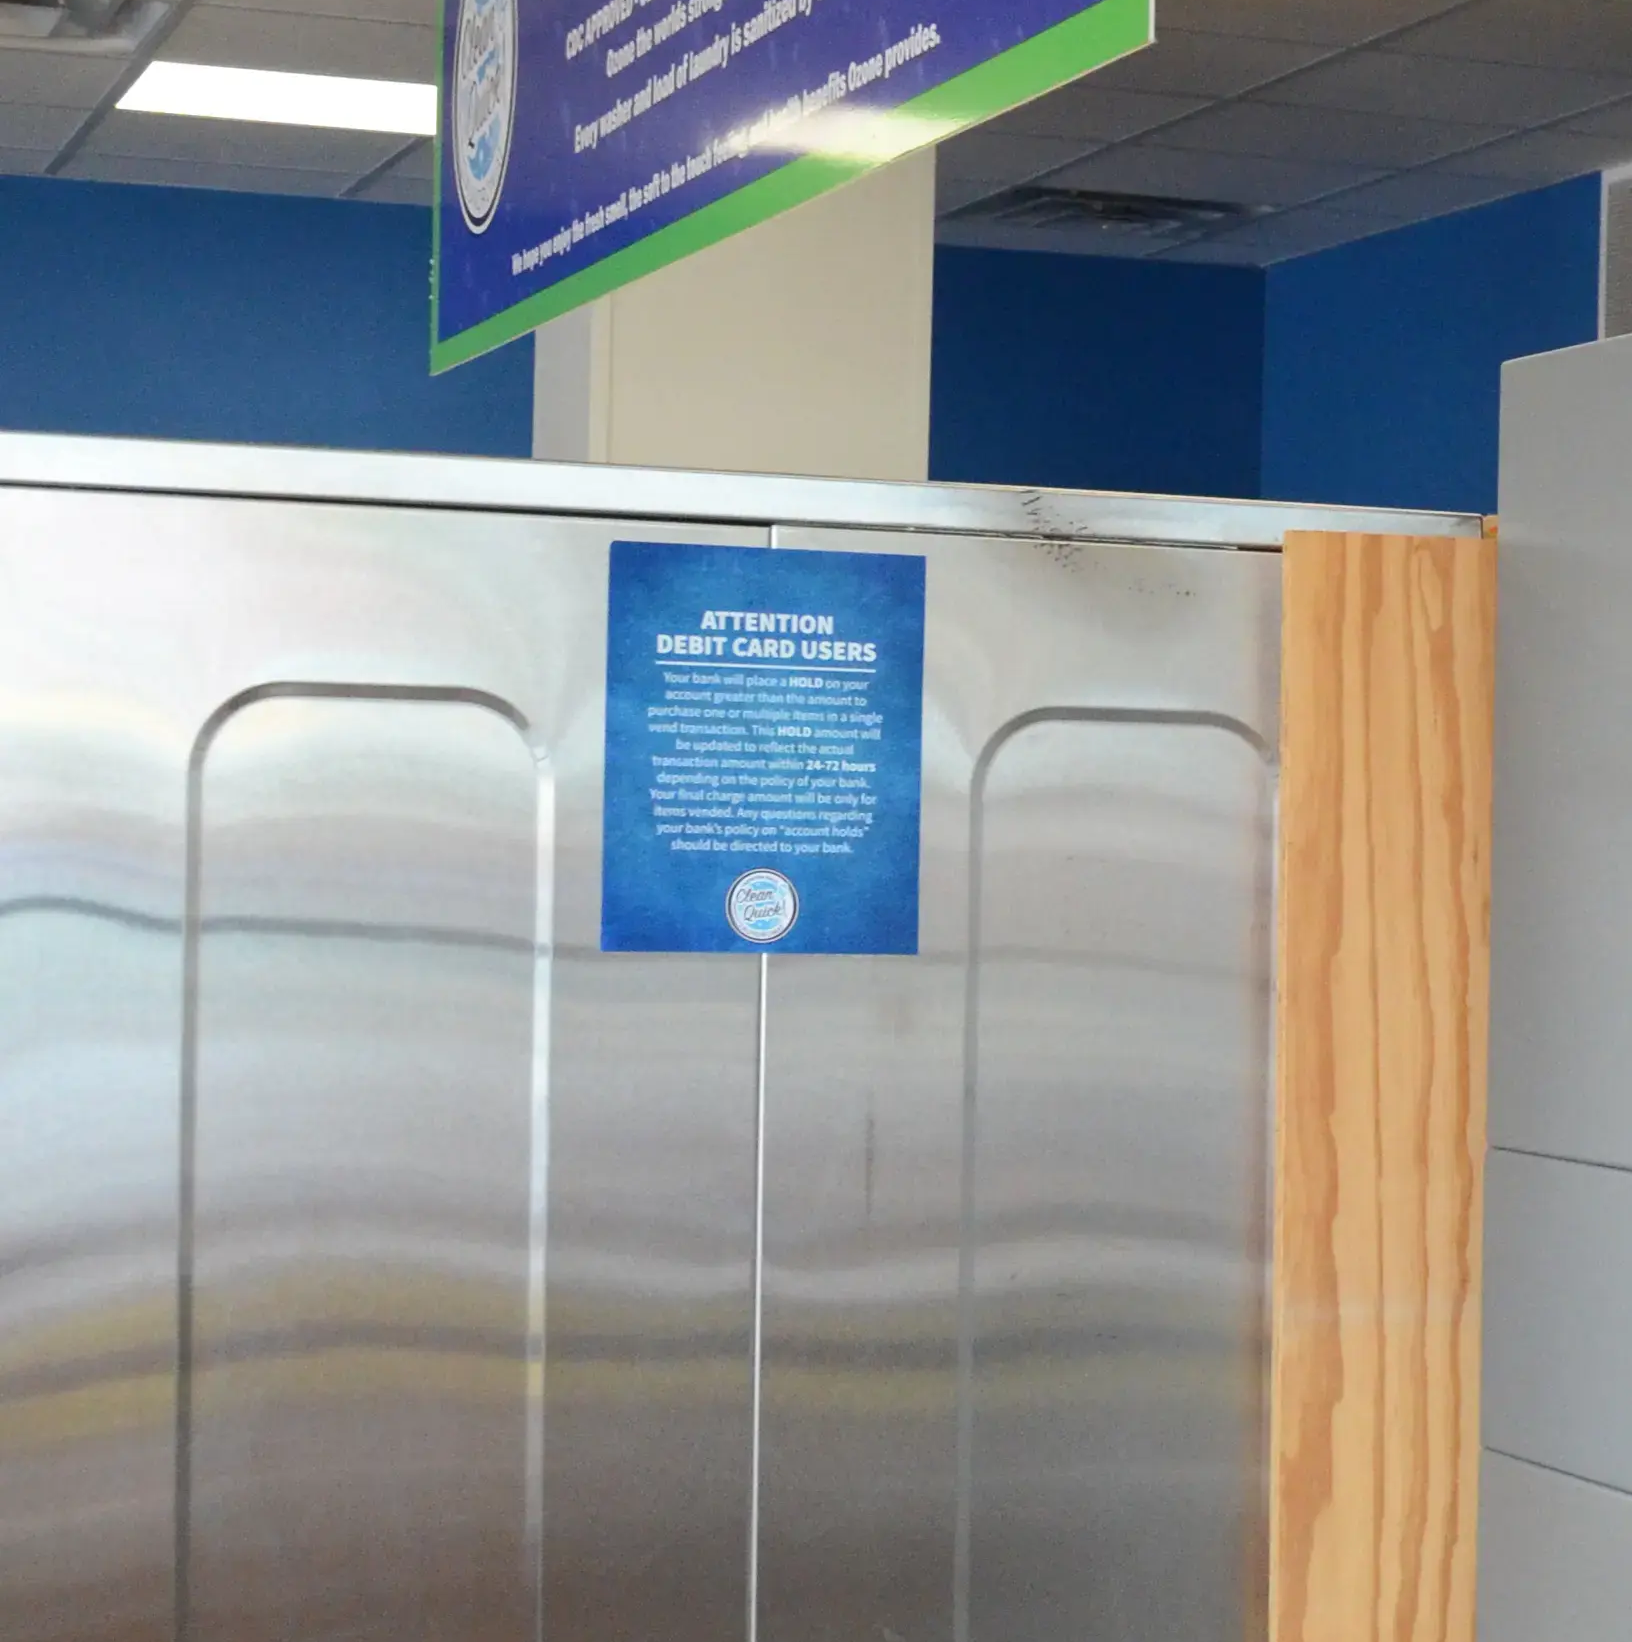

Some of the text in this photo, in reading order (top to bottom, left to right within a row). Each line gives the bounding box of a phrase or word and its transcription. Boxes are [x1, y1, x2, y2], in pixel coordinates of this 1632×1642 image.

[636, 26, 653, 58] the
[574, 121, 598, 154] Every
[633, 78, 652, 117] and
[653, 63, 675, 104] load
[676, 53, 688, 89] of
[689, 34, 729, 82] laundry
[731, 22, 742, 55] is
[671, 162, 685, 189] the
[848, 53, 882, 92] Ozone
[884, 23, 941, 78] provides.
[701, 610, 834, 635] ATTENTION
[656, 634, 877, 663] DEBIT CARD USERS
[663, 672, 869, 692] Your bank will place a HOLD on your
[665, 690, 867, 707] account greater than the amount to
[648, 705, 701, 718] purchase
[704, 709, 725, 718] one
[727, 709, 740, 718] or
[743, 708, 791, 722] multiple
[827, 712, 838, 721] in
[840, 713, 847, 722] a
[850, 711, 883, 726] single
[648, 722, 881, 740] vend transaction. This HOLD amount will
[676, 738, 854, 755] be updated to reflect the actual
[652, 756, 718, 767] transaction
[721, 759, 766, 769] amount
[806, 760, 839, 771] 24-72
[842, 760, 876, 772] hours
[656, 771, 871, 789] depending on the policy of your bank.
[649, 788, 677, 800] Your
[706, 790, 745, 804] charge
[747, 793, 792, 803] amount
[794, 792, 815, 804] will
[817, 794, 831, 804] be
[834, 794, 859, 808] only
[861, 793, 877, 805] for
[688, 807, 734, 817] vended.
[737, 808, 759, 821] Any
[760, 809, 817, 820] questions
[819, 810, 872, 824] regarding
[656, 824, 684, 835] your
[684, 822, 723, 834] bank's
[724, 824, 760, 838] policy
[762, 826, 777, 835] on
[670, 838, 854, 855] should be directed to your bank.
[736, 888, 773, 903] Clean
